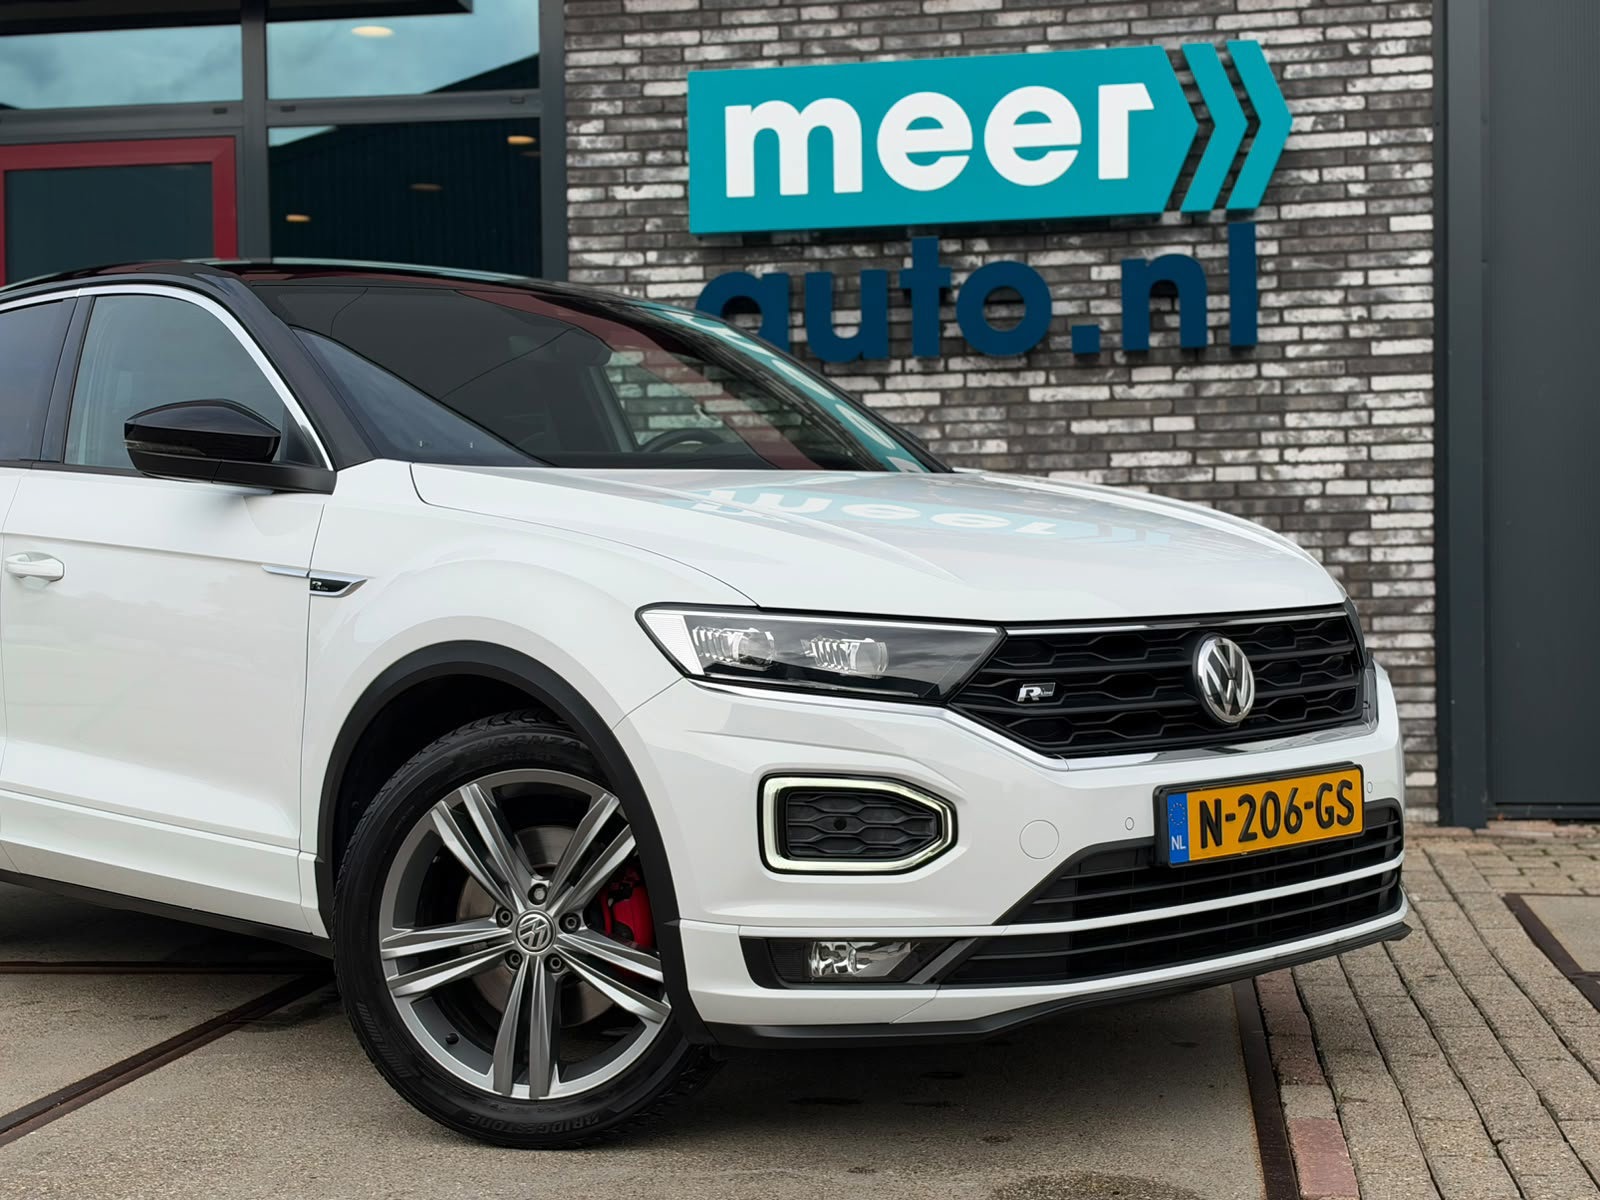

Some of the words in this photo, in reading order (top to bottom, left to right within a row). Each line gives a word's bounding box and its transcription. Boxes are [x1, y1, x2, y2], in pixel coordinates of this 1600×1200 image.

[724, 82, 1155, 198] meer
[694, 222, 1259, 362] auto.nl
[1171, 833, 1187, 851] NL
[1199, 778, 1355, 850] N-206-GS
[465, 1111, 600, 1135] BRIDGESTONE
